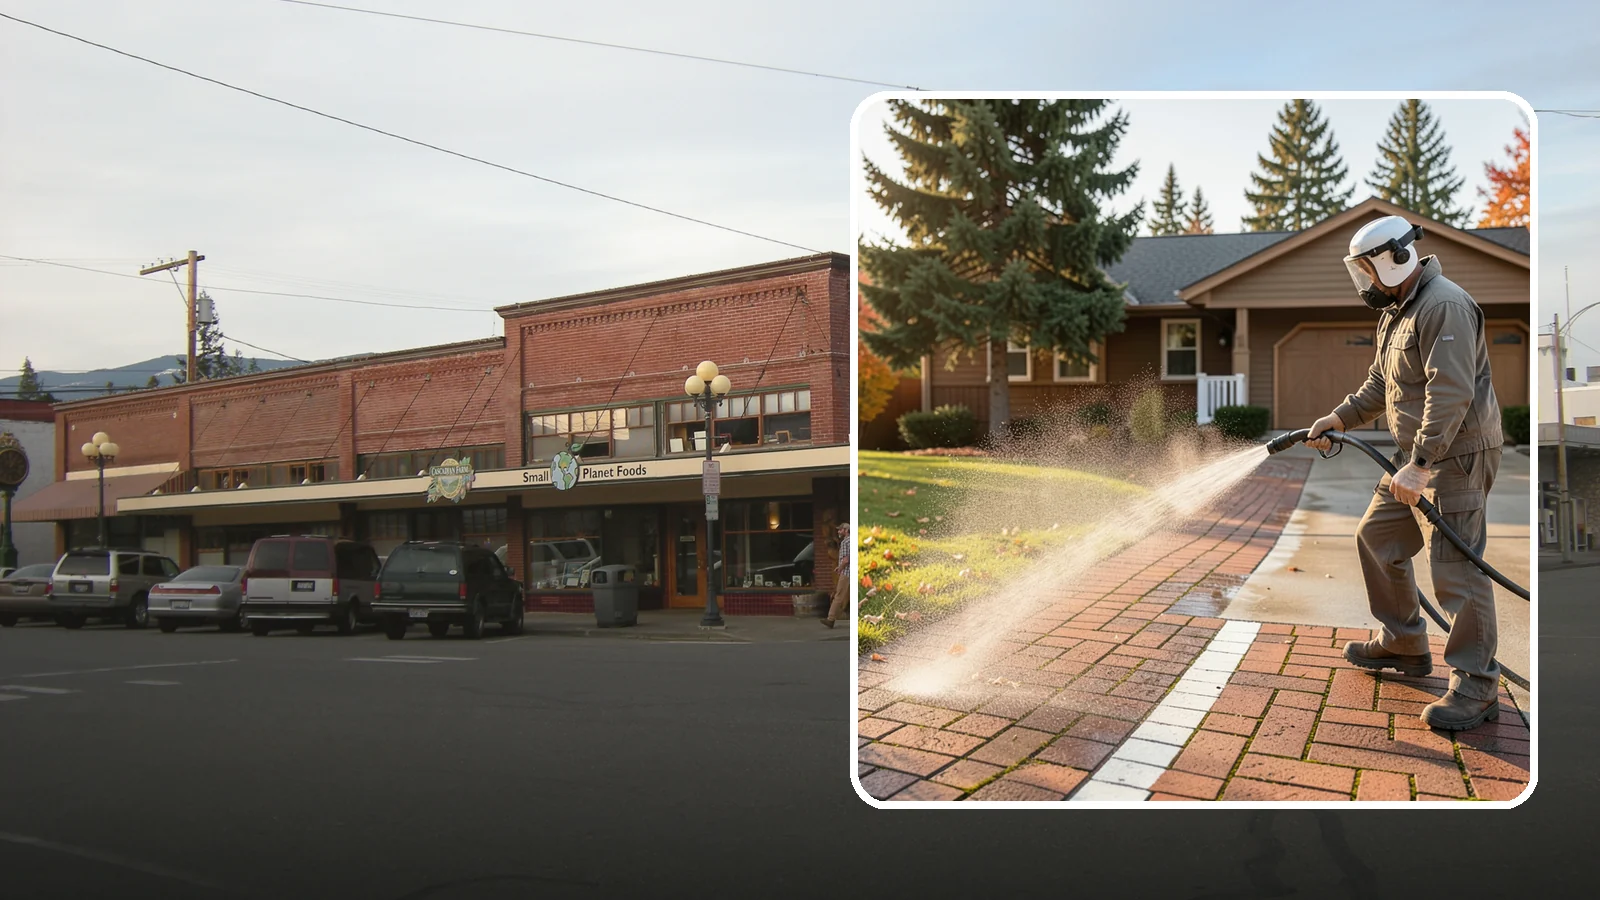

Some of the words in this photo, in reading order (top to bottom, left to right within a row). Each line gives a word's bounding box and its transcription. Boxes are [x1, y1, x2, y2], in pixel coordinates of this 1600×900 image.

[523, 471, 549, 482] Small
[583, 467, 614, 478] Planet
[617, 464, 647, 476] Foods
